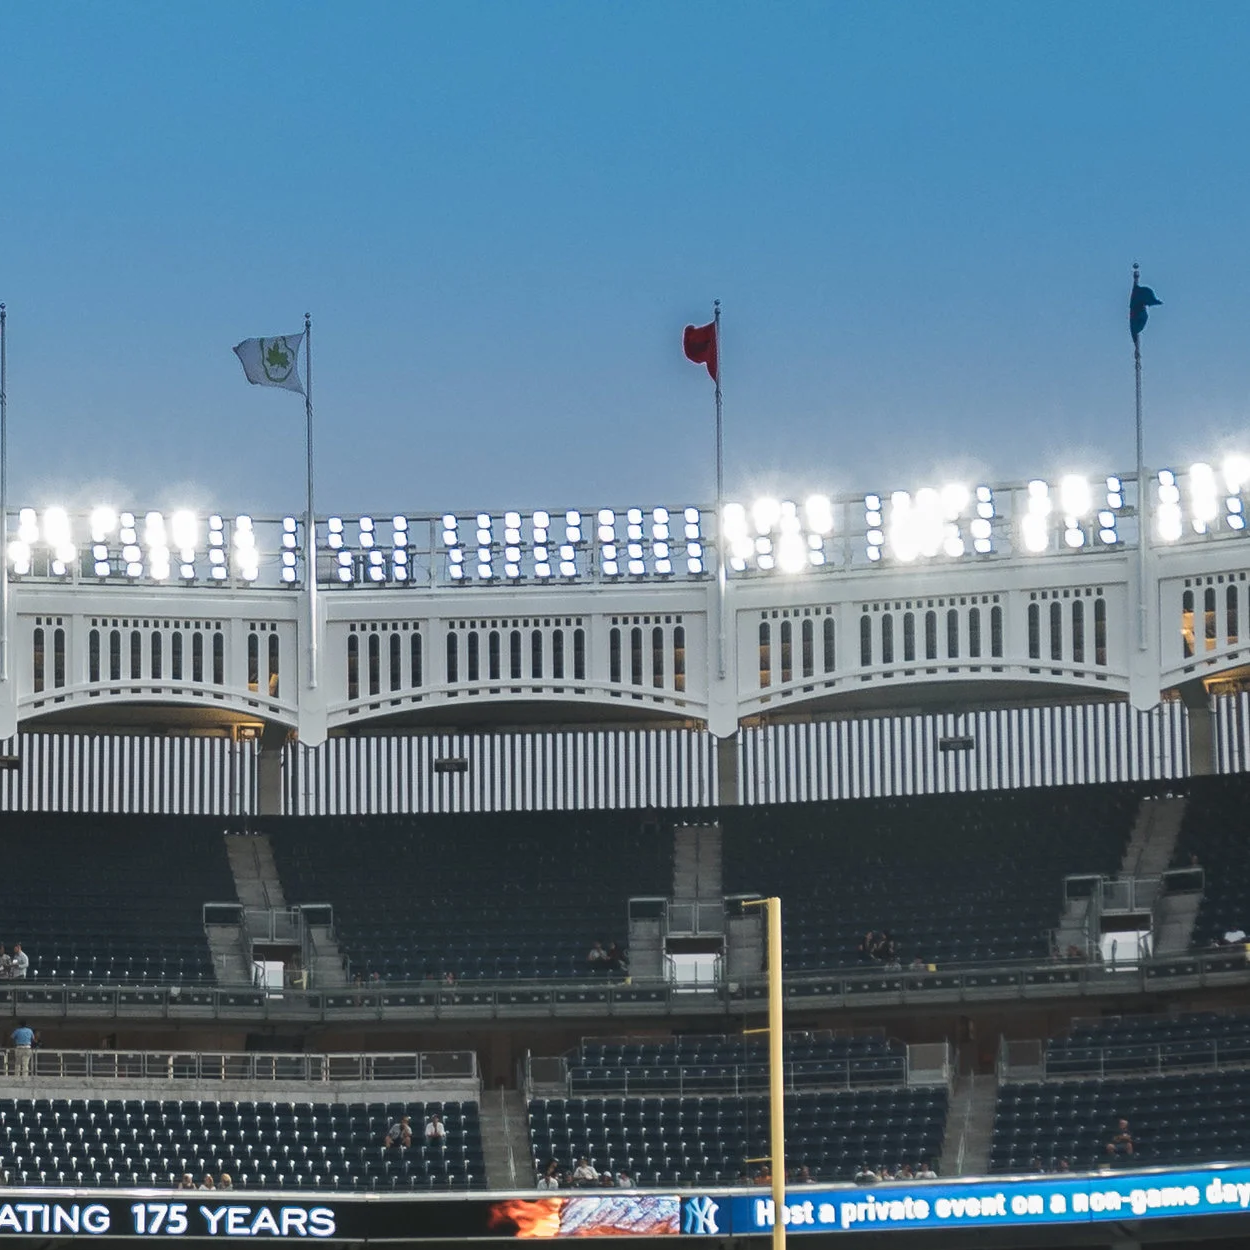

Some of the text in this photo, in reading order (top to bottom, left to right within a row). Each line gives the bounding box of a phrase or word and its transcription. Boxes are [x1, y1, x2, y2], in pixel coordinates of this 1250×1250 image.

[131, 1203, 188, 1234] 175
[201, 1205, 336, 1237] YEARS
[818, 1204, 835, 1224] a
[841, 1195, 929, 1229] private
[935, 1193, 1006, 1219] event
[1011, 1194, 1043, 1215] on
[1049, 1194, 1066, 1214] a
[1072, 1183, 1200, 1215] non-game
